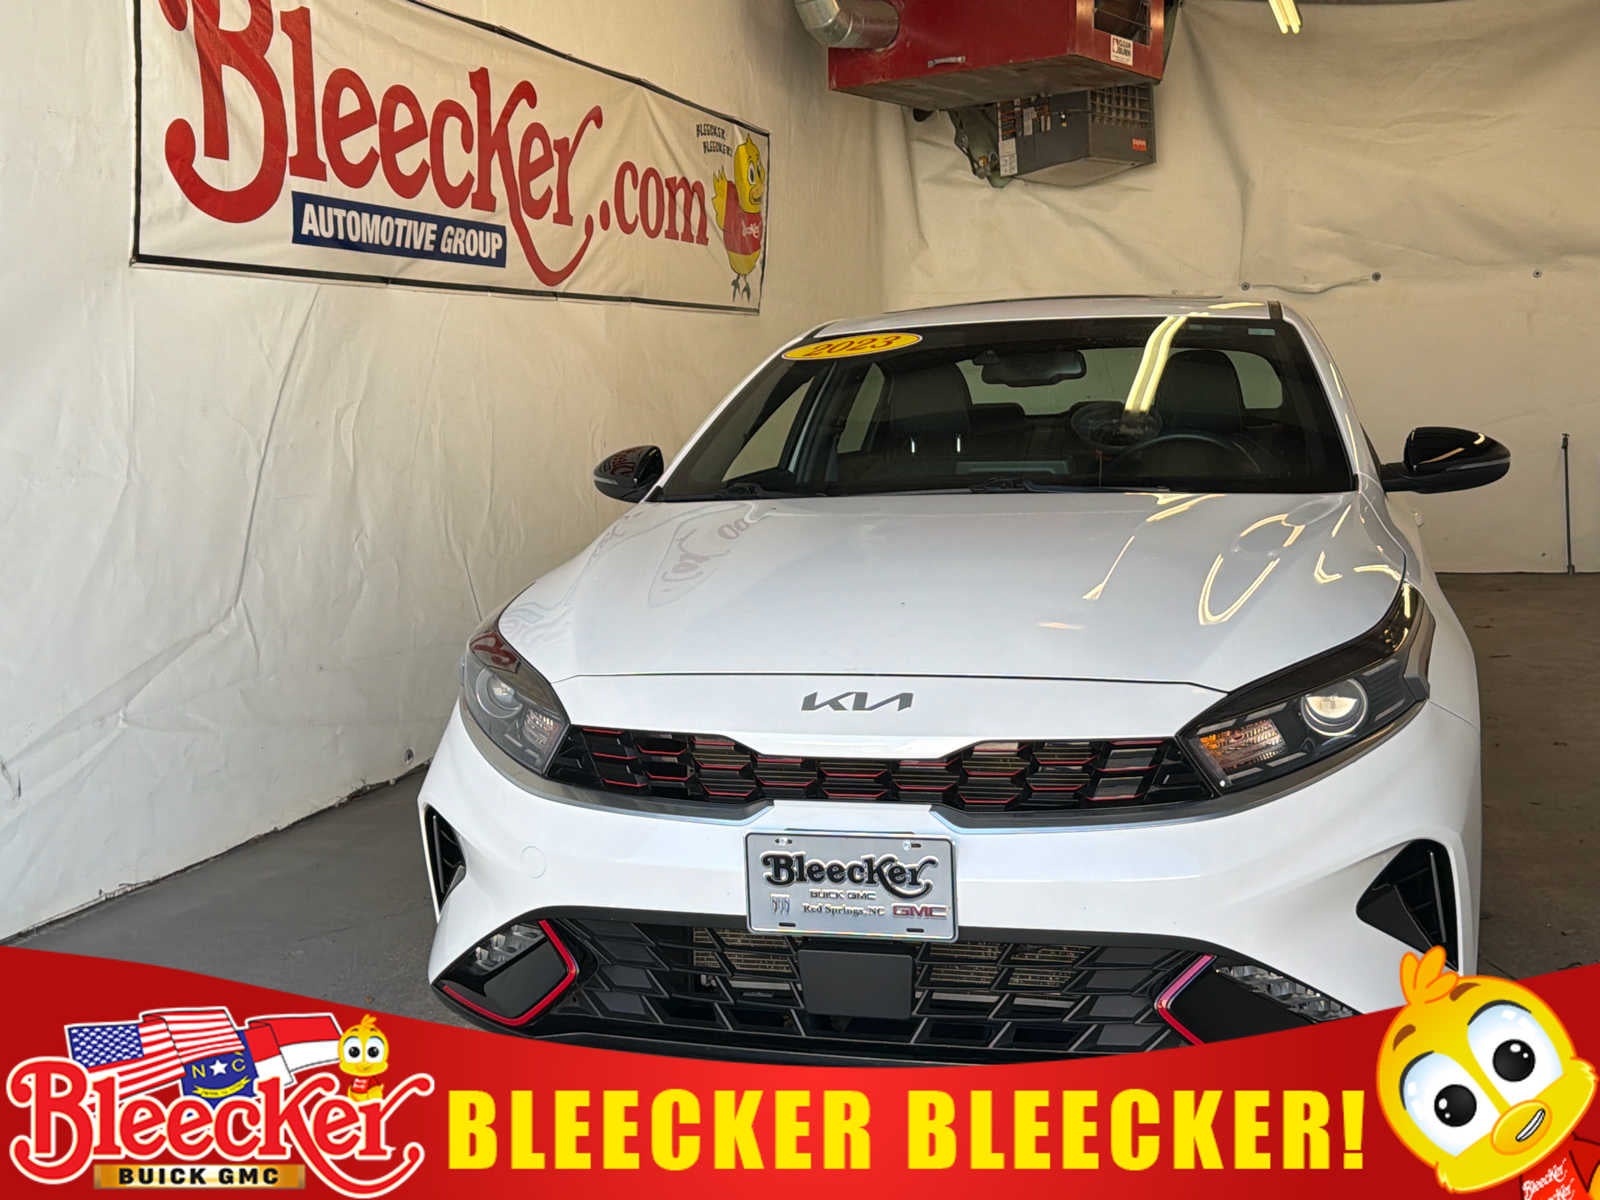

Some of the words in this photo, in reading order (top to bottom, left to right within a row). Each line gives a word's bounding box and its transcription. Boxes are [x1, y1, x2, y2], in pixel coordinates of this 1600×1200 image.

[301, 203, 438, 252] AUTOMOTIVE
[440, 225, 503, 260] GROUP
[801, 335, 902, 358] 2023
[761, 853, 938, 899] Bleecker
[810, 889, 844, 900] BUICK
[847, 891, 876, 901] GMC
[803, 903, 823, 914] Red
[892, 904, 948, 919] GMC
